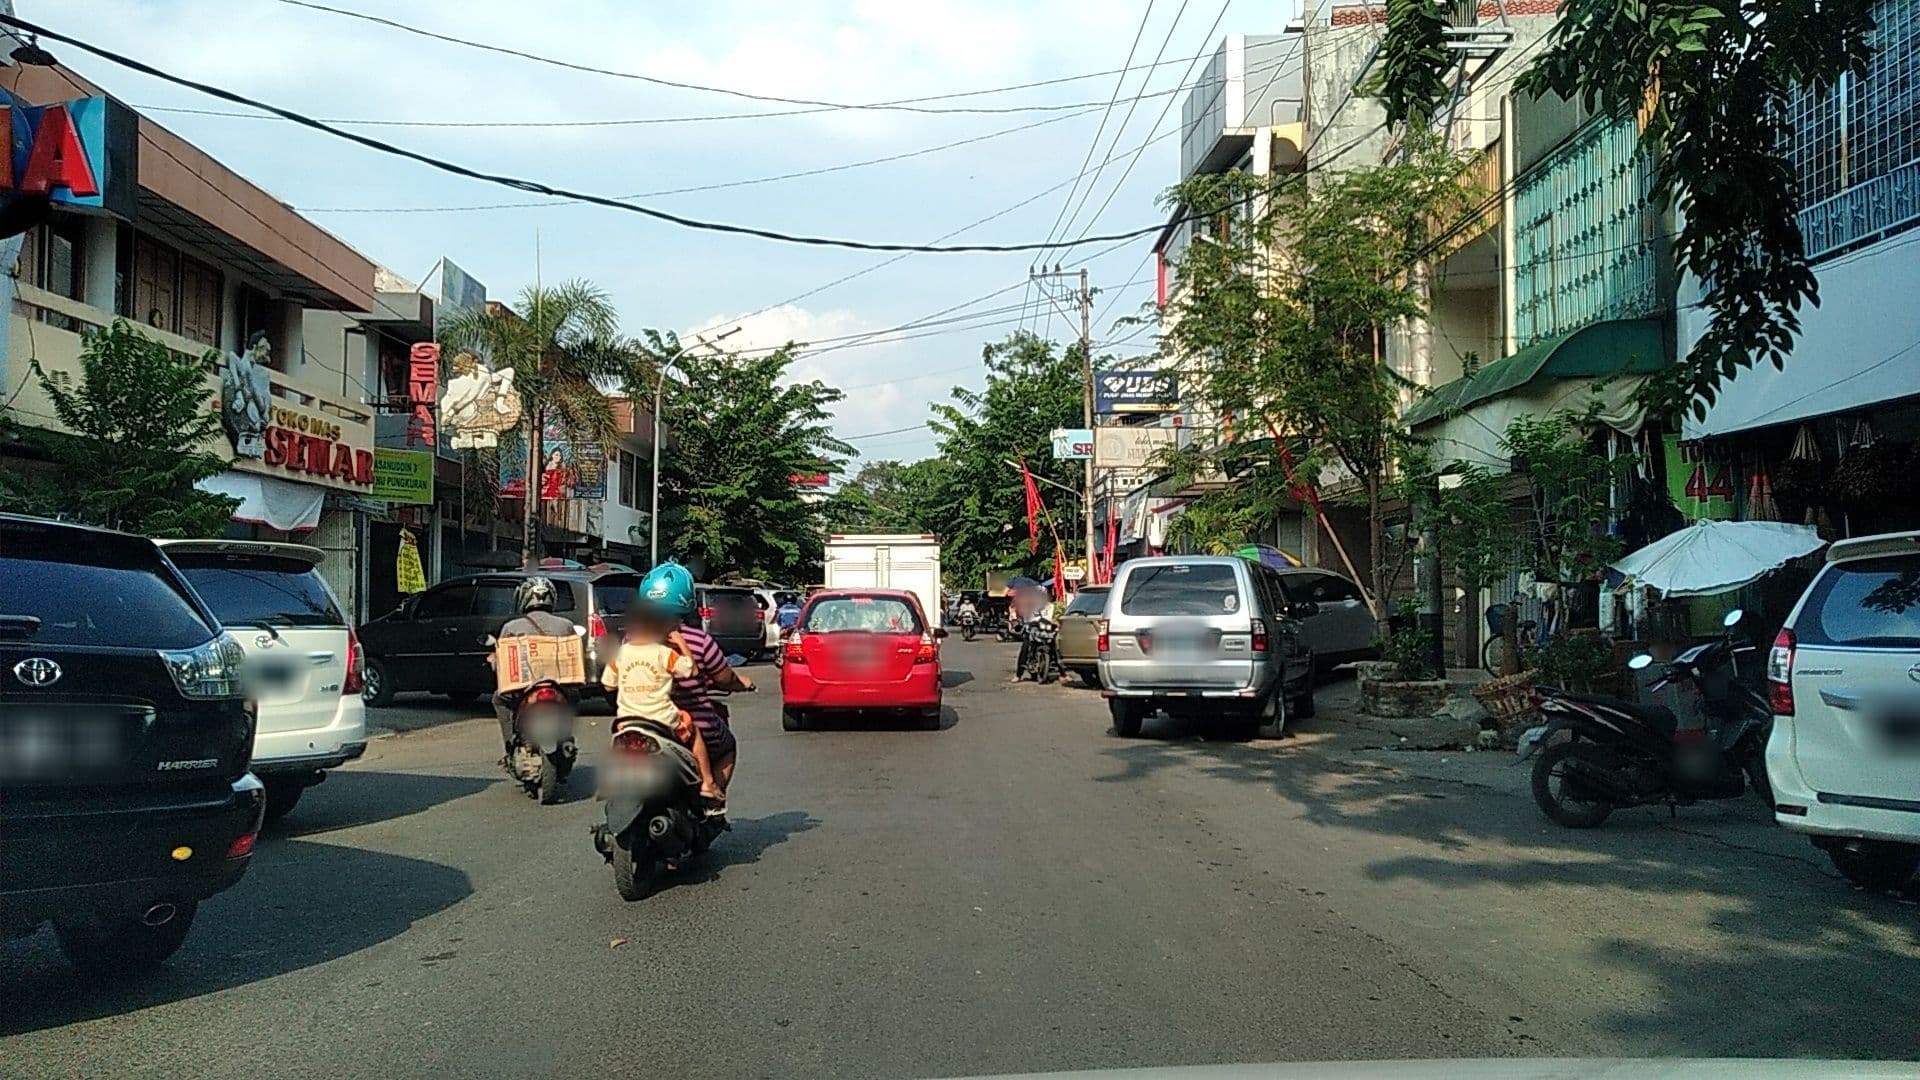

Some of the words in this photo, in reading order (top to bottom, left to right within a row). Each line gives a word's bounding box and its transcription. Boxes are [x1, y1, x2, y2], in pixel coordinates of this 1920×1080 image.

[407, 342, 440, 447] SEMAR
[310, 419, 342, 442] MAS
[264, 425, 375, 486] SEMAR
[1685, 465, 1734, 503] 44
[157, 758, 219, 771] HARRIER
